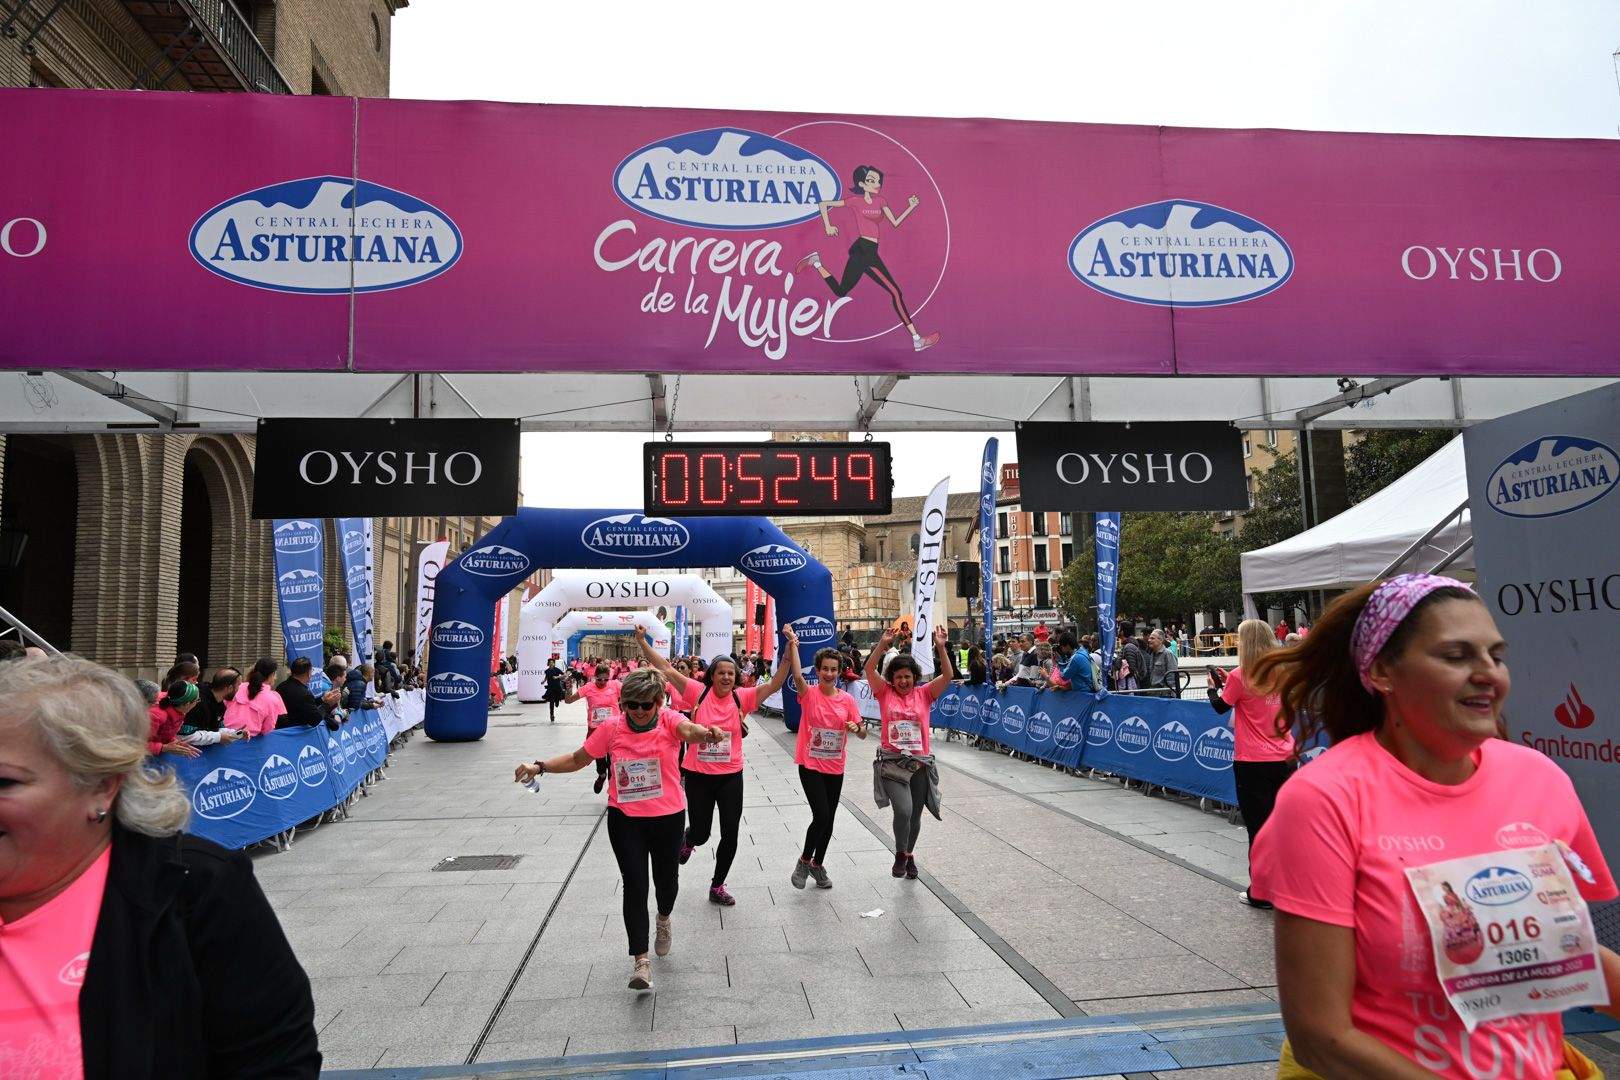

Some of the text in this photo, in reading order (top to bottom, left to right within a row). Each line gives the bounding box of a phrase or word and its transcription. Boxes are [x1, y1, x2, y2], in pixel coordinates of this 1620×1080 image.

[667, 160, 816, 175] CENTRAL LECHERA
[631, 162, 822, 204] ASTURIANA
[255, 216, 433, 229] CENTRAL LECHERA
[0, 217, 47, 257] O
[210, 218, 442, 263] ASTURIANA
[1121, 236, 1268, 247] CENTRAL LECHERA
[594, 219, 782, 276] Carrera
[1087, 238, 1278, 278] ASTURIANA
[1401, 245, 1562, 282] OYSHO
[640, 272, 853, 360] de la Mujer
[299, 450, 482, 486] OYSHO
[1055, 452, 1213, 484] OYSHO
[1512, 453, 1603, 479] CENTRAL LECHERA
[1496, 465, 1611, 505] ASTURIANA
[589, 527, 682, 547] ASTURIANA
[464, 556, 524, 569] ASTURIANA
[746, 556, 802, 568] ASTURIANA
[916, 508, 943, 642] OYSHO
[586, 580, 670, 599] OYSHO
[1498, 574, 1620, 616] OYSHO
[433, 630, 480, 643] ASTURIANA
[429, 682, 475, 694] ASTURIANA
[1089, 727, 1111, 739] TURIANA
[1117, 728, 1148, 746] ASTURIANA
[1155, 734, 1188, 753] ASTURIANA
[264, 772, 297, 792] ASTURIANA
[200, 786, 252, 812] ASTURIANA
[1378, 835, 1445, 851] OYSHO
[1471, 881, 1530, 900] ASTURIANA
[1487, 916, 1541, 944] 016
[1496, 947, 1539, 966] 13061
[1502, 972, 1515, 983] DE
[1517, 970, 1528, 980] LA
[1406, 991, 1448, 1021] TU
